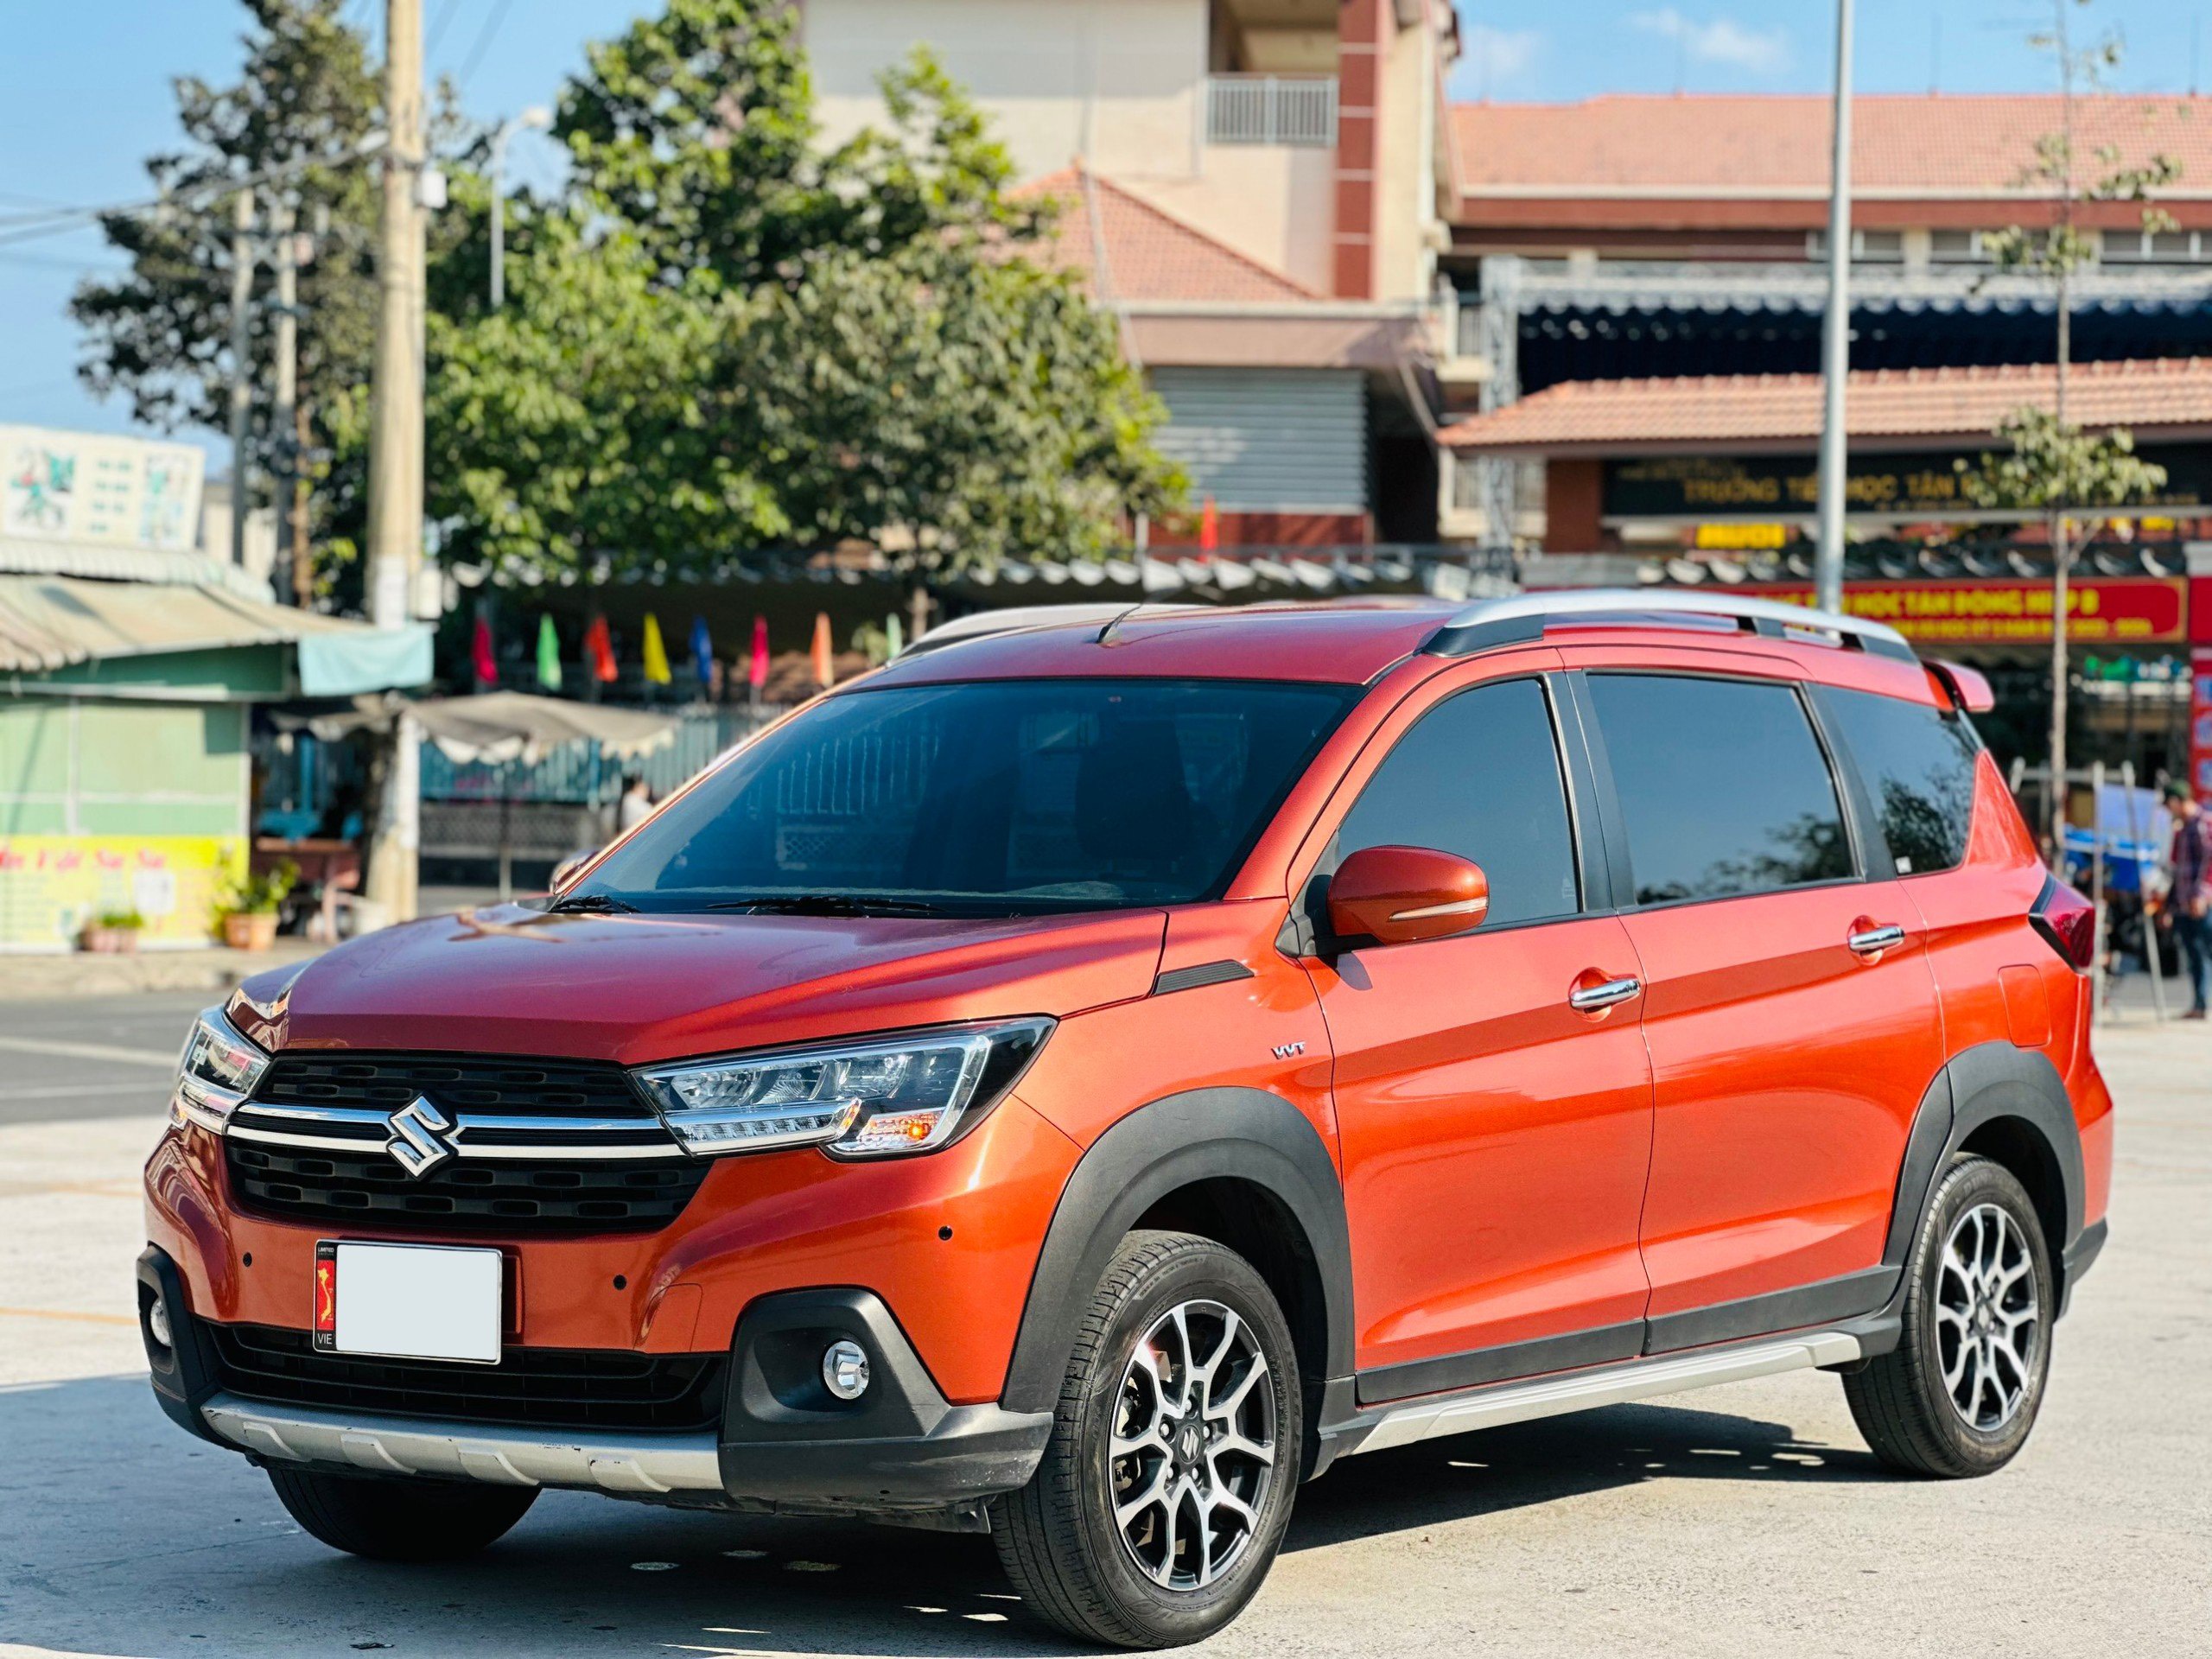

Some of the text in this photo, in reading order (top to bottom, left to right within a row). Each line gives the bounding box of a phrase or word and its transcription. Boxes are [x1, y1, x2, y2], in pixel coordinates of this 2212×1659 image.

[2025, 588, 2079, 616] HIP
[1271, 1040, 1306, 1059] VVT
[317, 1333, 333, 1344] VIE
